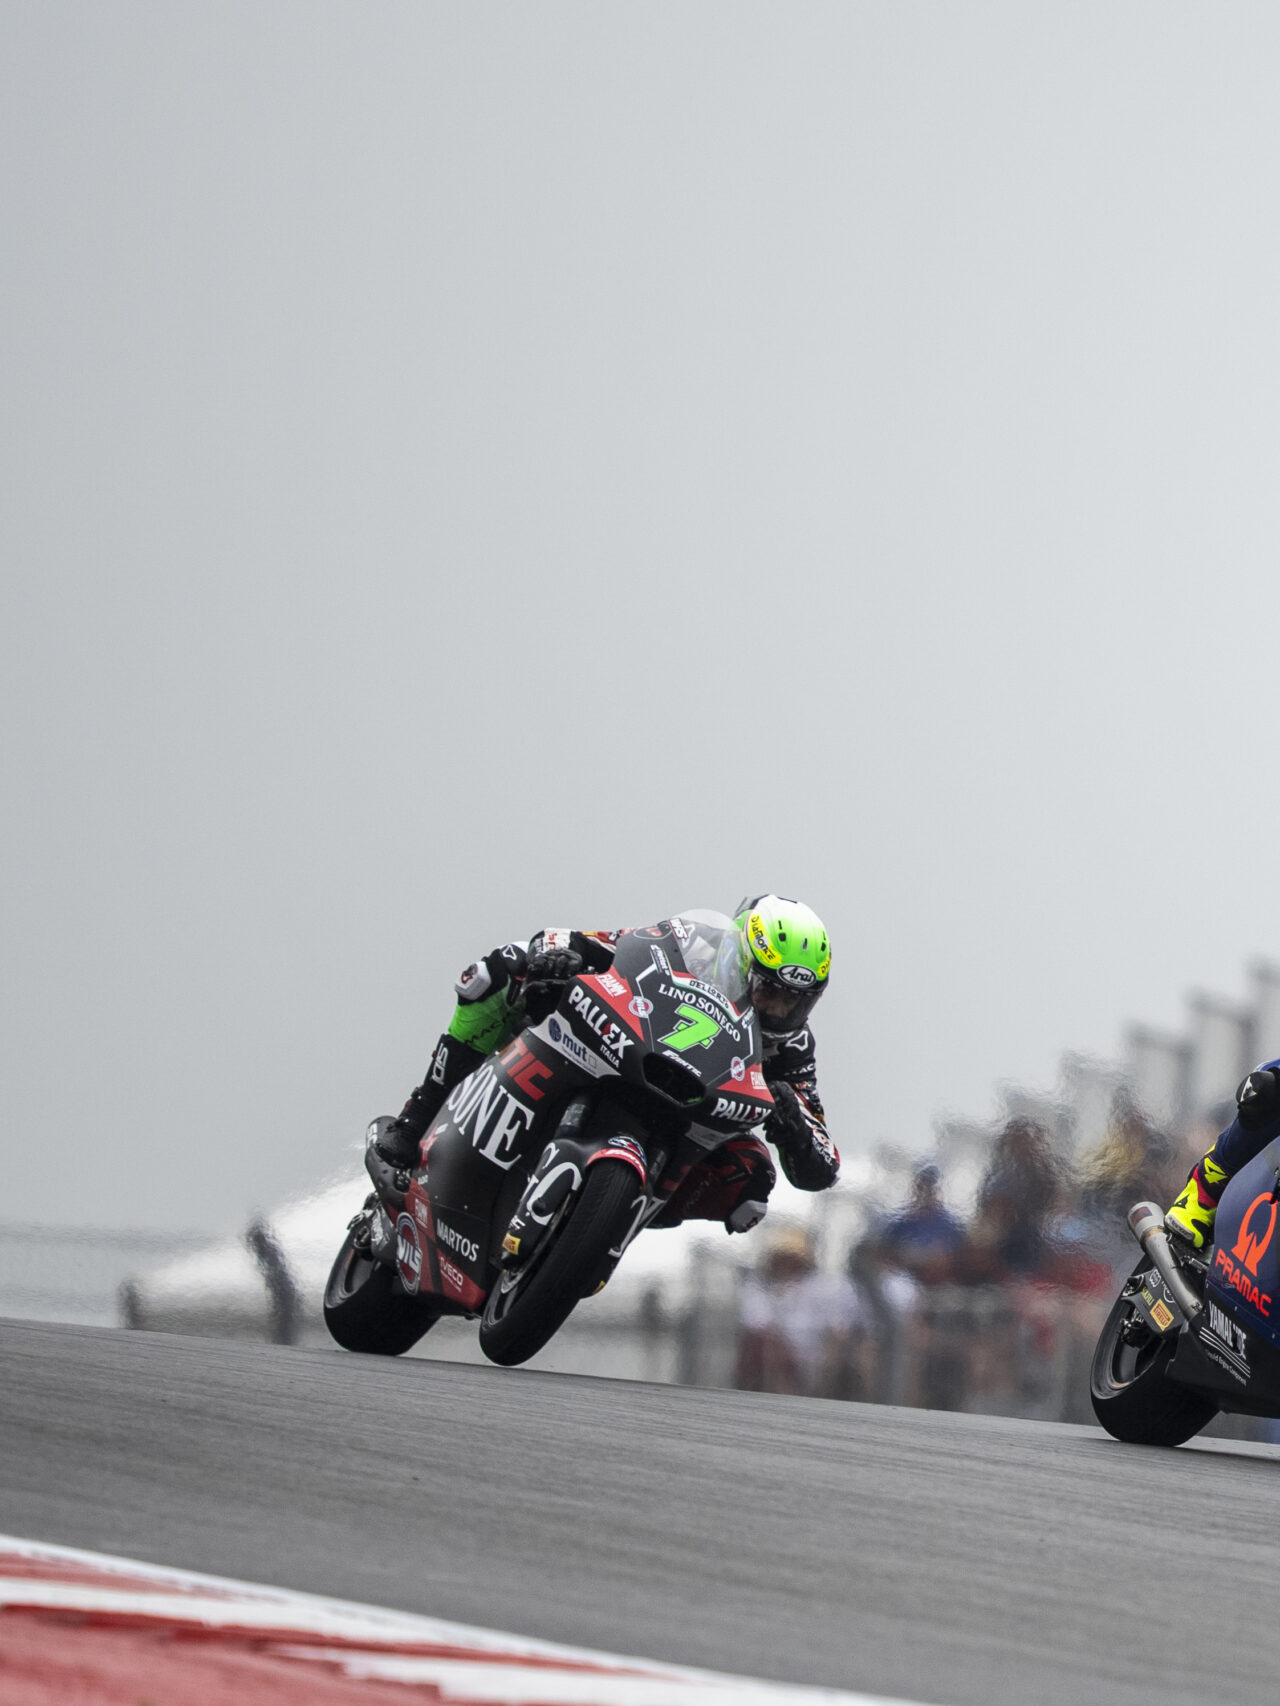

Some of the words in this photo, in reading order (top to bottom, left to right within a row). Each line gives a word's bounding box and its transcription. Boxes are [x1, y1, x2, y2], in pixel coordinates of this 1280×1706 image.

[782, 966, 813, 984] Arai
[568, 985, 635, 1059] PALLEX
[657, 1003, 722, 1052] 7
[658, 984, 696, 1004] LINO
[696, 997, 741, 1042] SONEGO
[600, 1044, 620, 1068] ITALIA
[397, 1234, 422, 1274] NILS
[436, 1218, 479, 1262] MARTOS
[1214, 1248, 1273, 1317] PRAMAC
